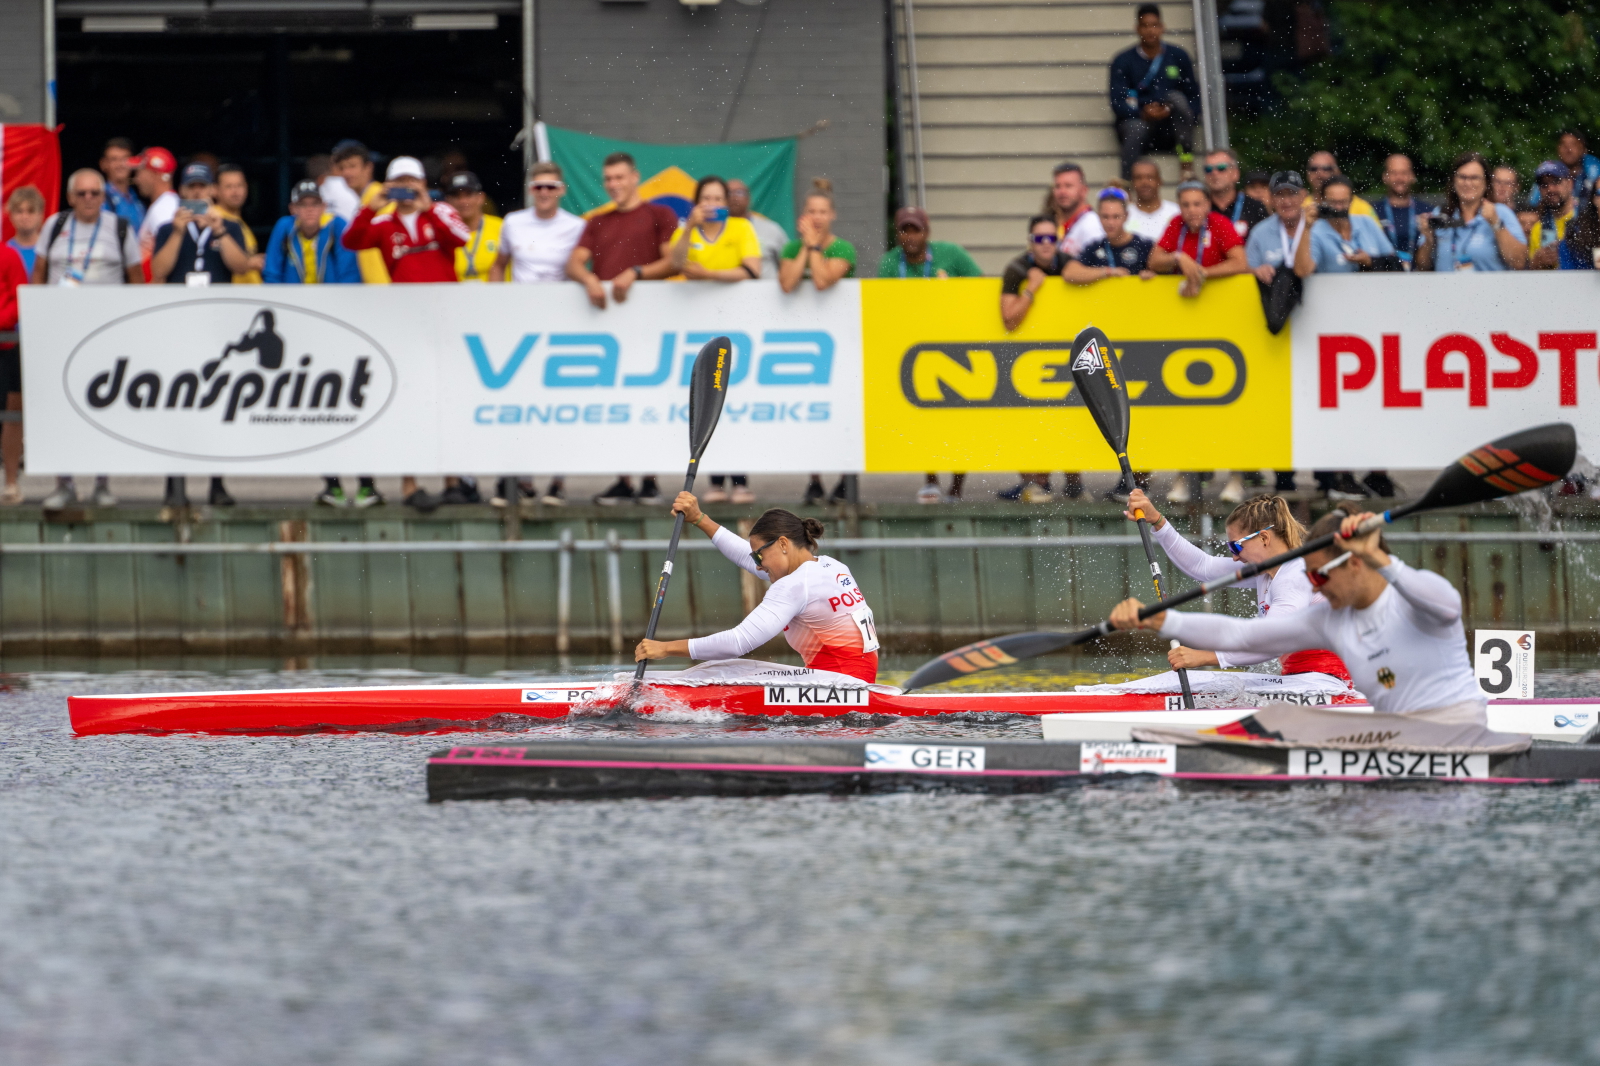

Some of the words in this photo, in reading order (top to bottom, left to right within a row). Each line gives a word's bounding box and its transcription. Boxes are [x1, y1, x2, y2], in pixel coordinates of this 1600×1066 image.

[1317, 330, 1600, 409] PLAST
[87, 357, 371, 423] dansprint
[667, 401, 832, 423] KYAKS
[1479, 638, 1513, 695] 3
[567, 690, 595, 702] PO
[769, 687, 791, 704] M.
[798, 687, 863, 704] KLATT
[911, 747, 976, 768] GER
[1305, 750, 1328, 774] P.
[1341, 751, 1471, 777] PASZEK
